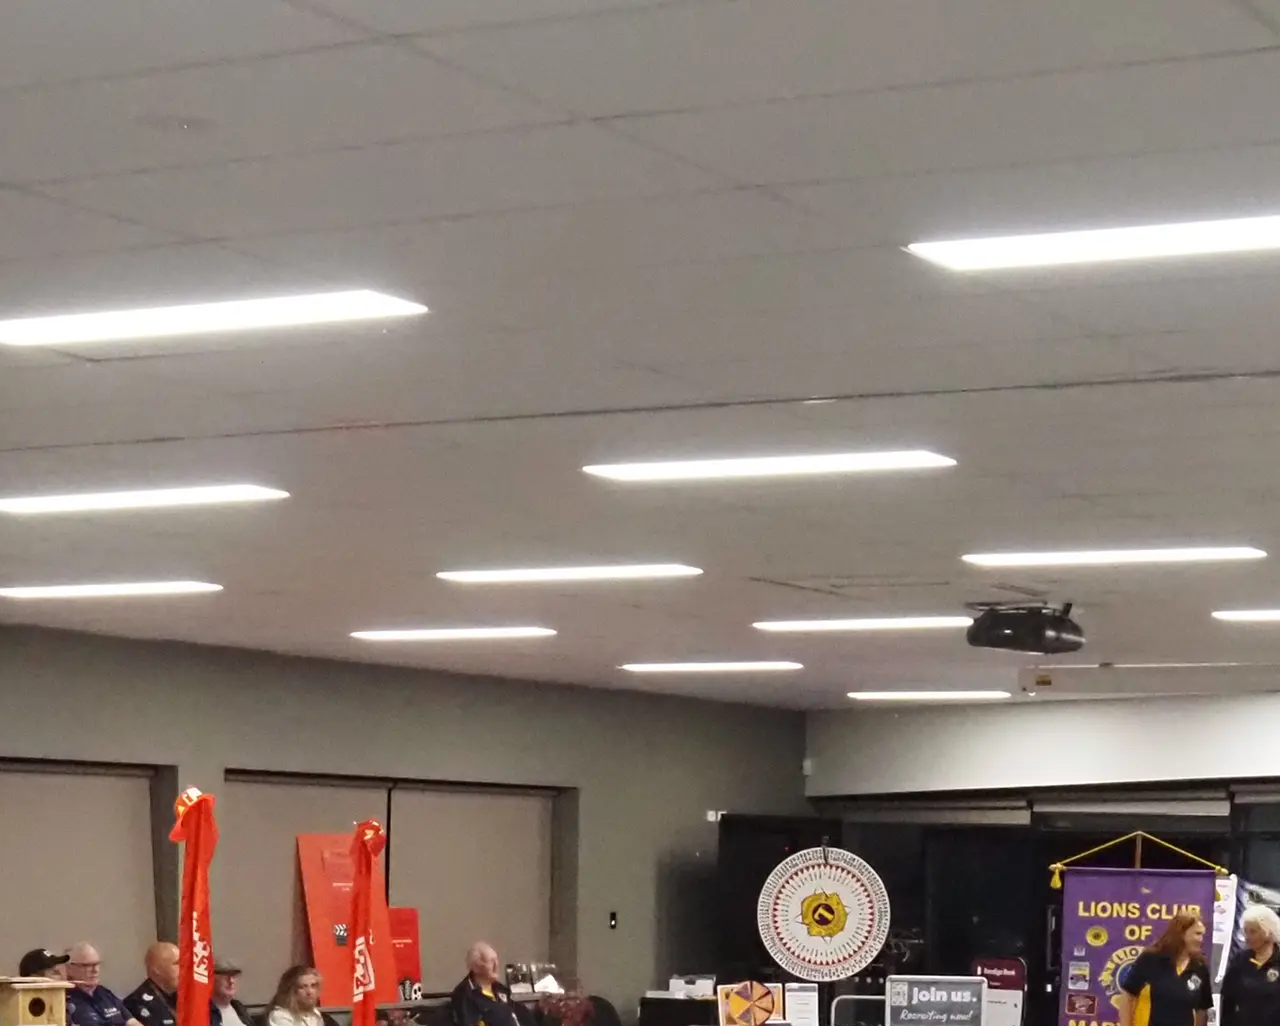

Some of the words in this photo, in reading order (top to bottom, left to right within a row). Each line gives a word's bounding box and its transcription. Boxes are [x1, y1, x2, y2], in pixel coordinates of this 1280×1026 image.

[1078, 901, 1140, 918] LIONS
[1125, 925, 1152, 941] OF
[951, 991, 977, 1002] us.
[900, 1009, 947, 1023] Recruiting
[950, 1010, 973, 1021] now!
